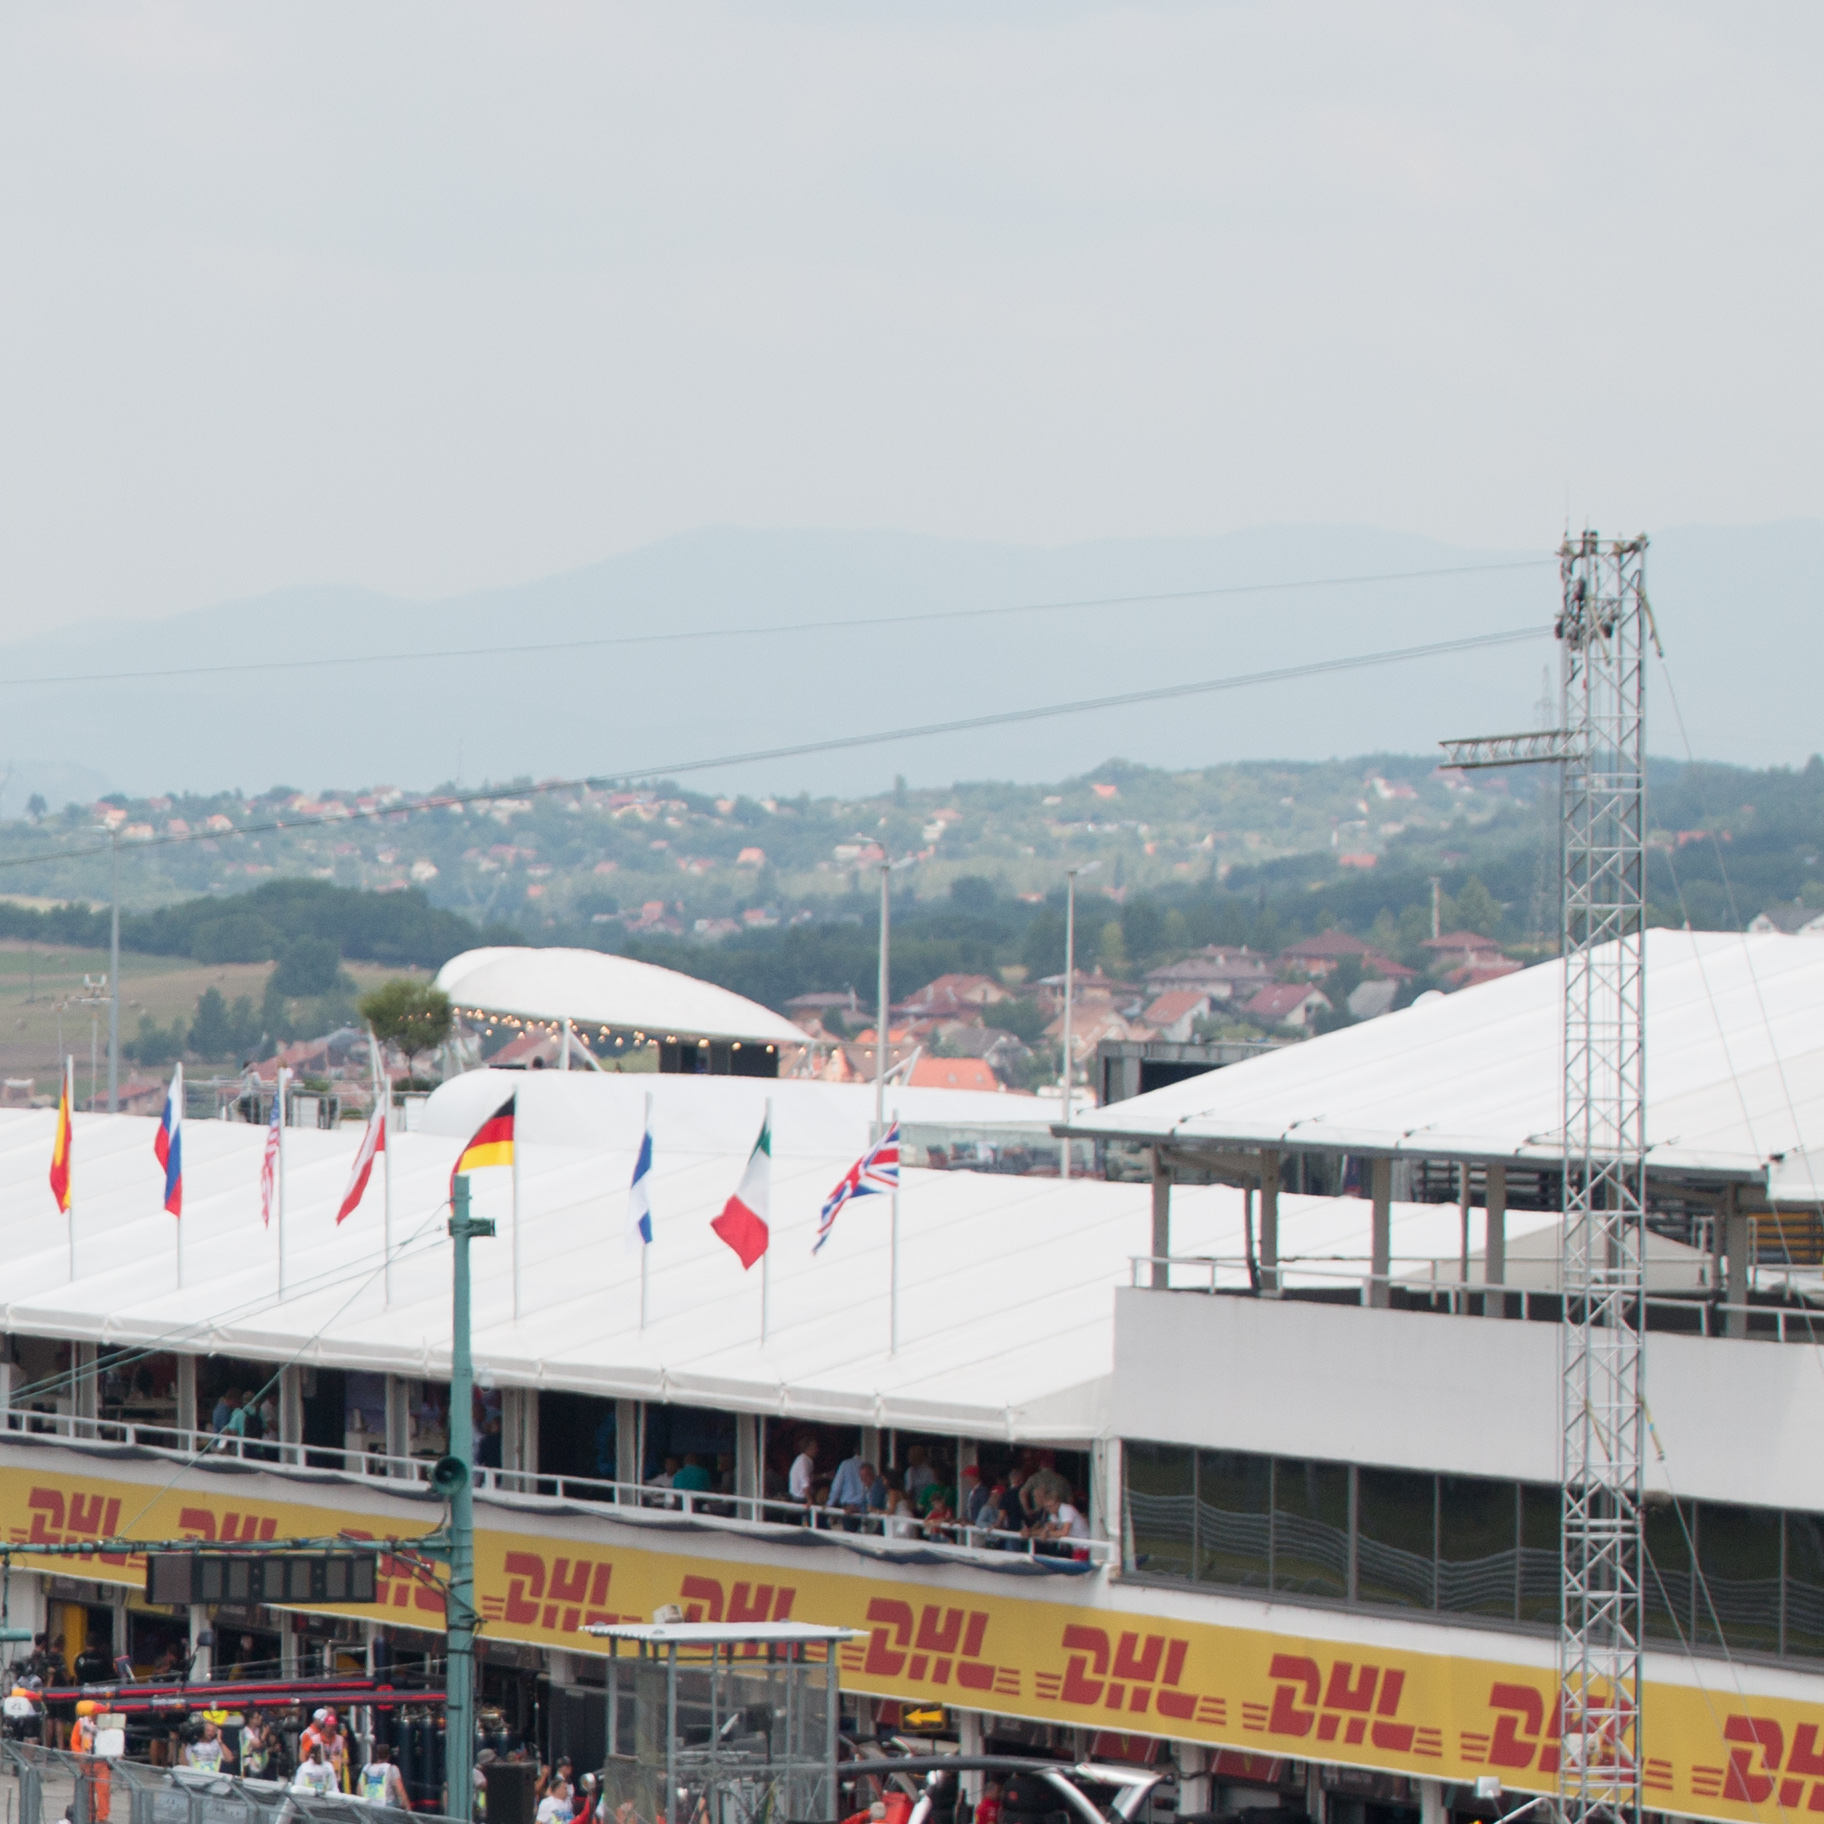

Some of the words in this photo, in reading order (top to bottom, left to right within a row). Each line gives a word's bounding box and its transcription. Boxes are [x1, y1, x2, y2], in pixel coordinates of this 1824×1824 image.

[507, 1552, 610, 1634] DHL
[866, 1599, 994, 1693] DHL
[1062, 1625, 1196, 1723] DHL
[1269, 1653, 1414, 1755] DHL
